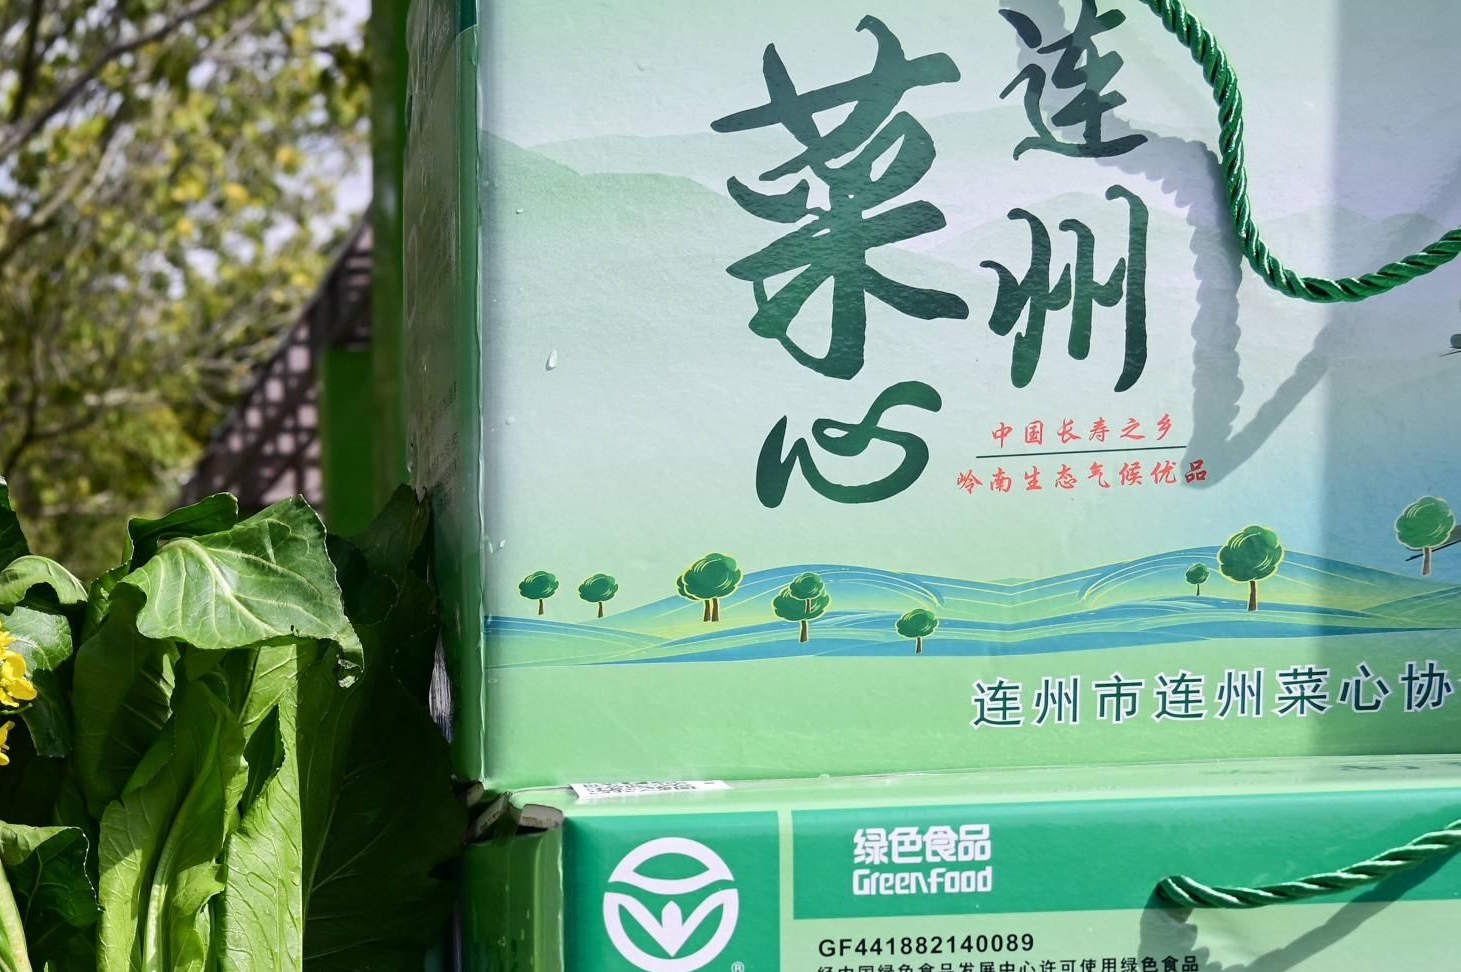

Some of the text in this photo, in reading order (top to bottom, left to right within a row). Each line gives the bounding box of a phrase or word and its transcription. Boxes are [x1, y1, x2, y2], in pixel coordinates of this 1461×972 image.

[712, 13, 969, 509] 菜心
[991, 413, 1174, 448] 中国长寿之乡
[956, 458, 1209, 495] 岭南生态气候优品
[972, 661, 1454, 728] 连州市连州菜心协
[853, 823, 991, 865] 绿色食品
[817, 933, 1035, 957] GF441882140089
